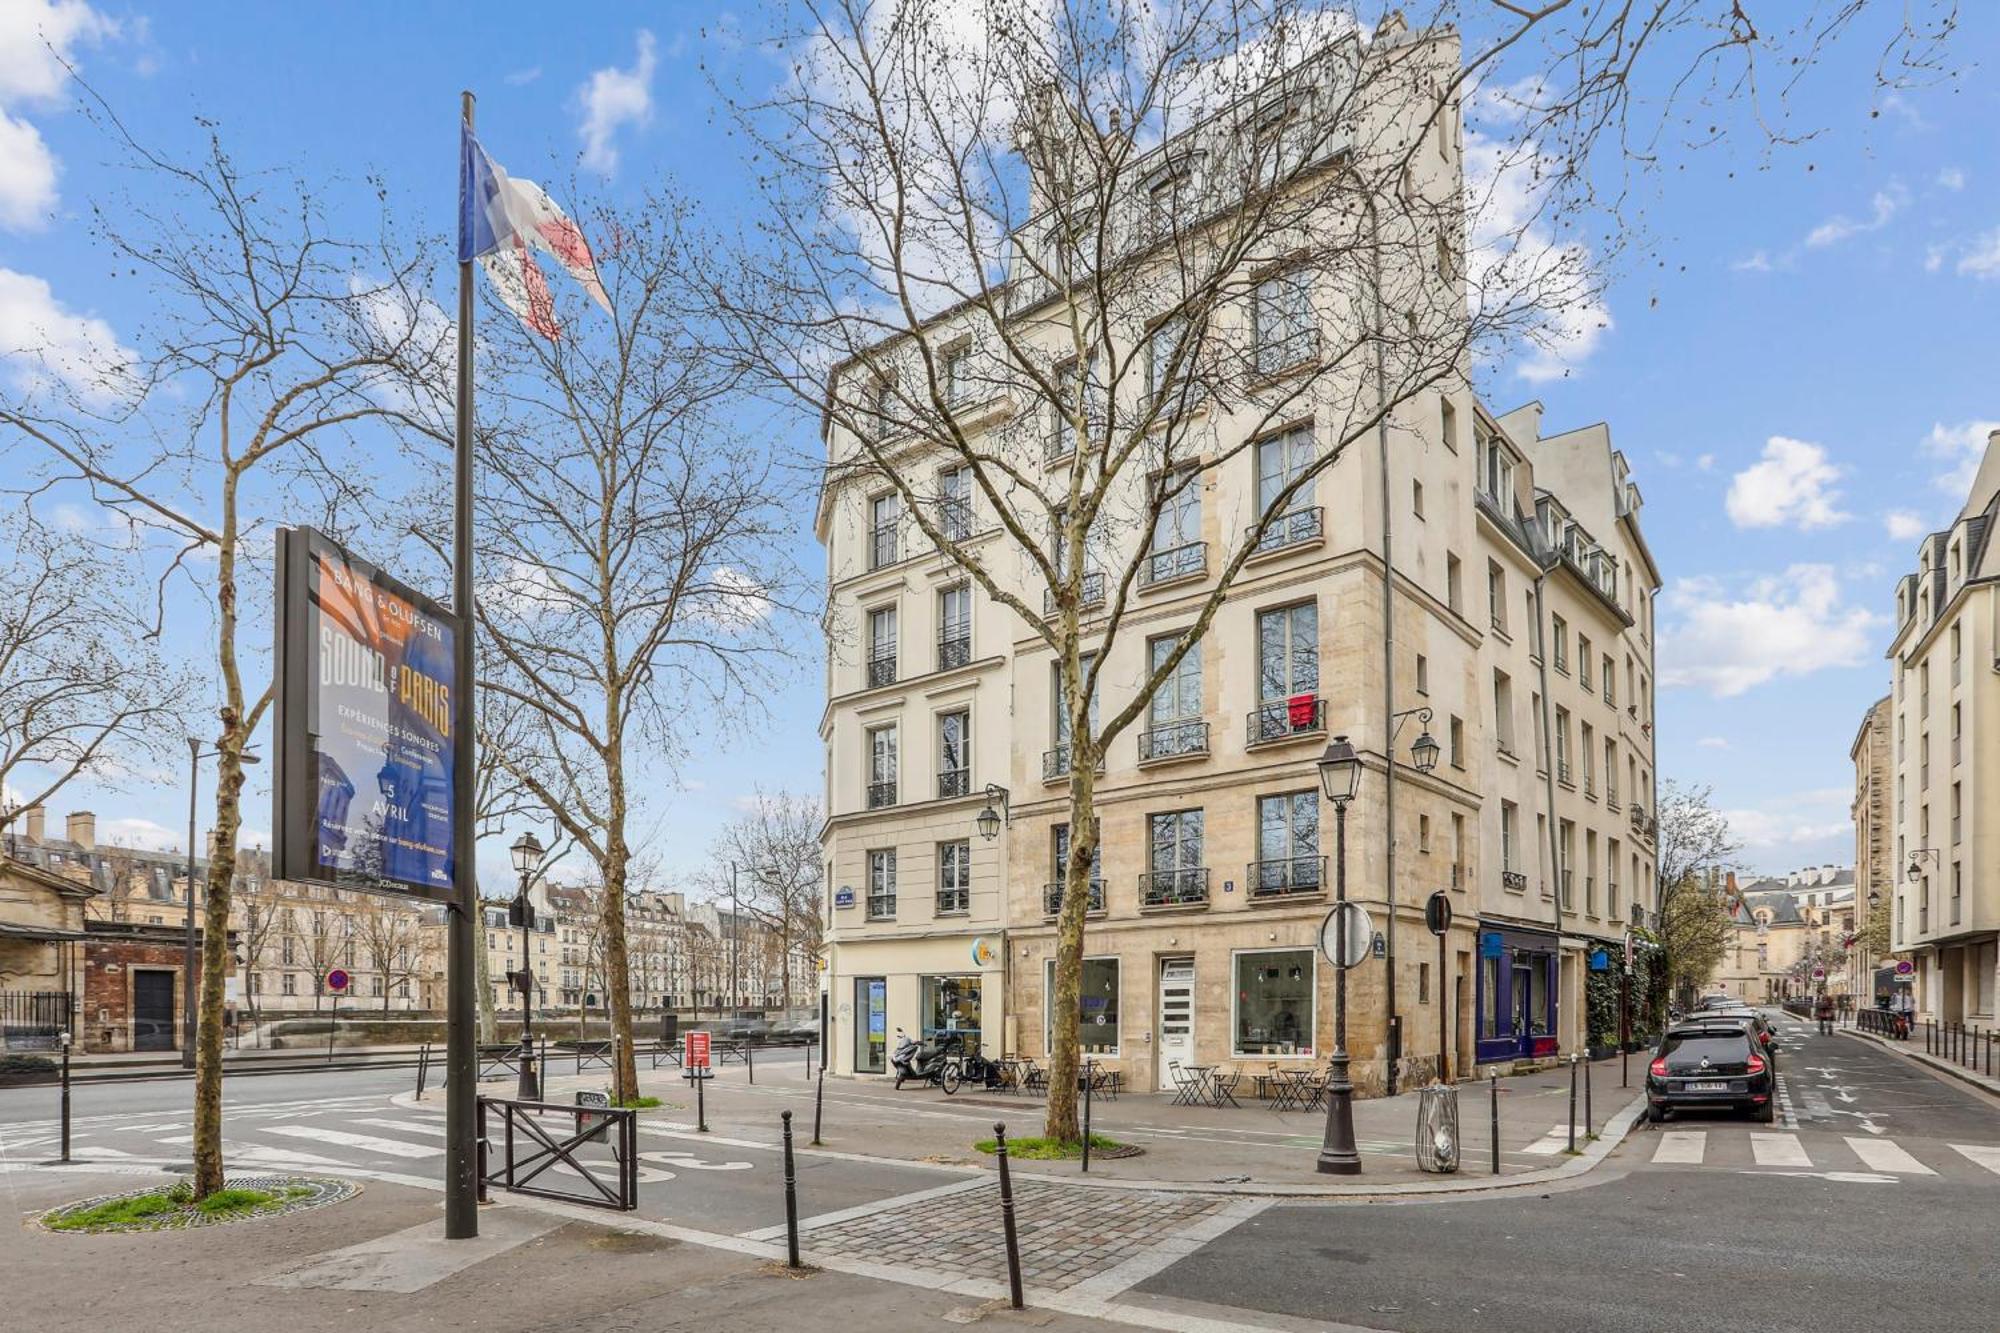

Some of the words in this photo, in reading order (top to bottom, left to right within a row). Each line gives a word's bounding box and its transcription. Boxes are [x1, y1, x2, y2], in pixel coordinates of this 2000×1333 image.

[335, 569, 373, 603] BANG
[377, 594, 387, 609] &
[388, 602, 441, 641] OLUFSEN
[320, 626, 385, 693] SOUND
[390, 665, 397, 694] OF
[401, 664, 449, 738] PARIS
[338, 704, 401, 737] EXPÉRIENCES
[402, 729, 440, 753] SONORES
[371, 800, 409, 822] AVRIL
[387, 784, 395, 798] 5
